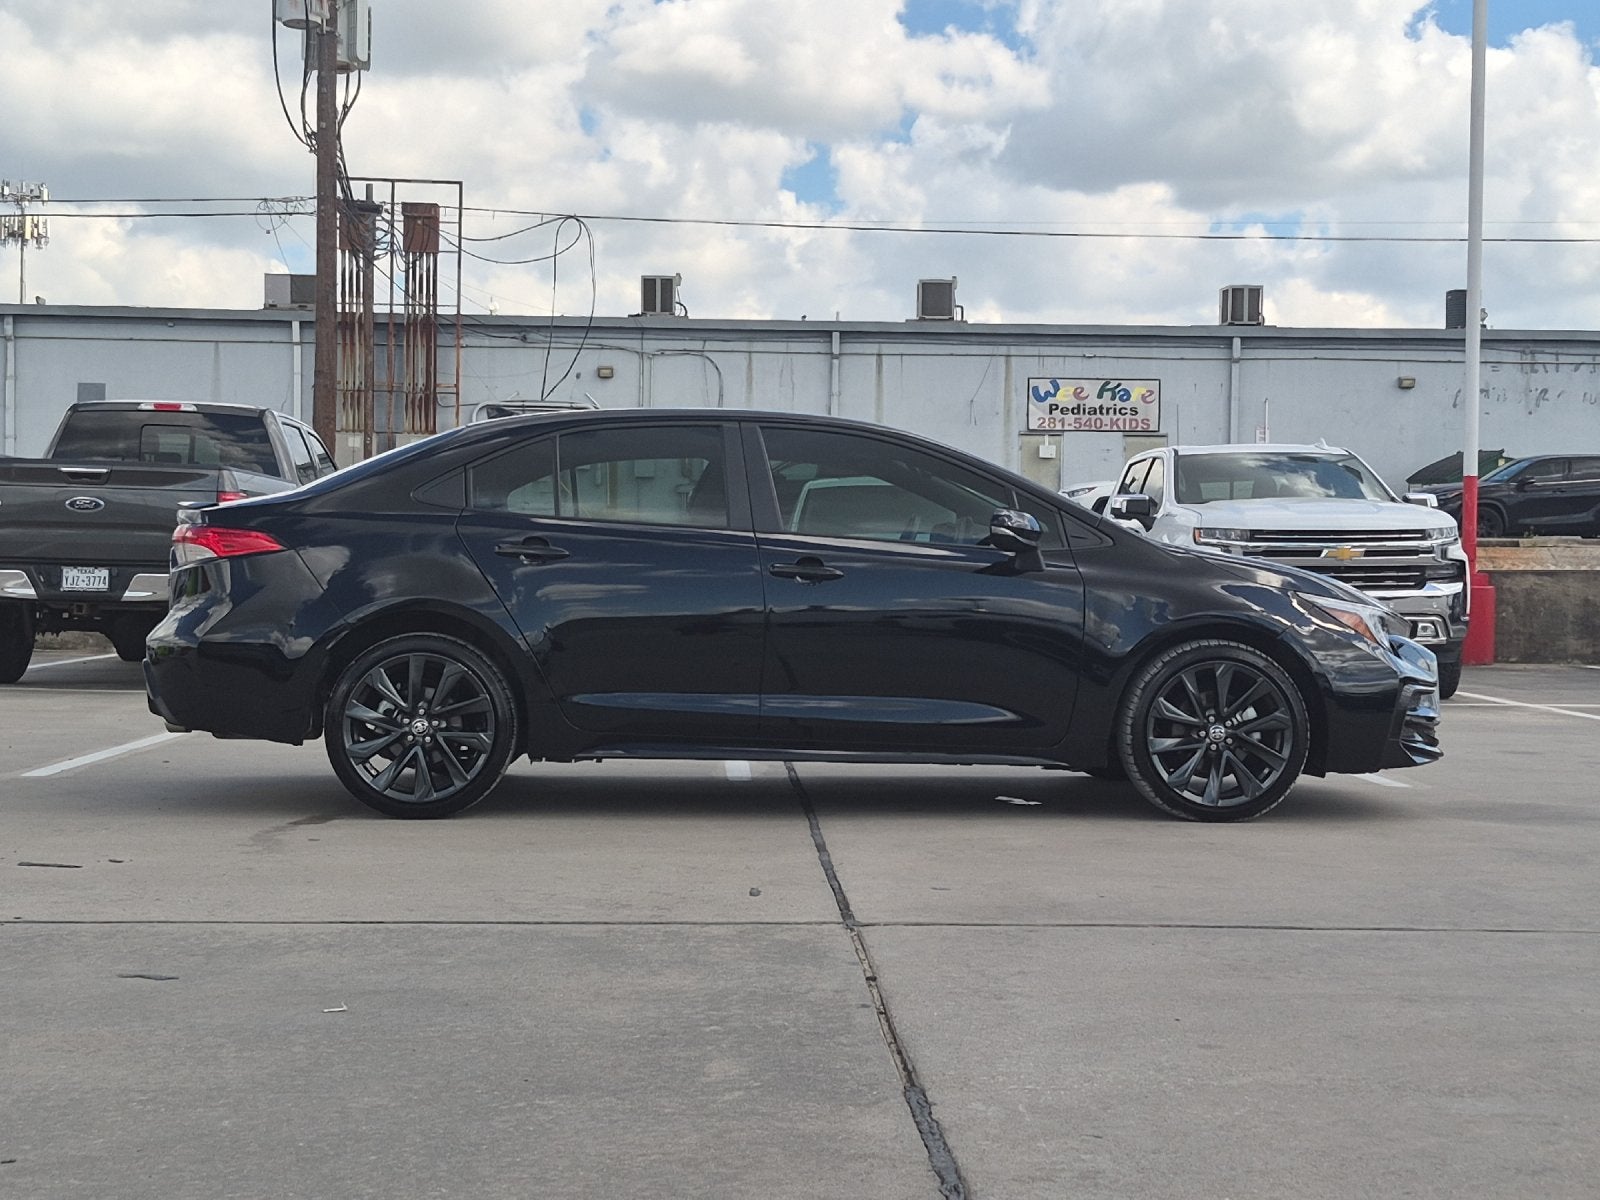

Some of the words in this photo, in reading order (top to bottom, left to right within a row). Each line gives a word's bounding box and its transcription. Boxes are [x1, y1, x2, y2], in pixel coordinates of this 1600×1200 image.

[1032, 379, 1089, 403] Wee
[1097, 381, 1155, 404] Kare
[1049, 403, 1139, 416] Pediatrics
[1037, 417, 1151, 430] 281-540-KIDS
